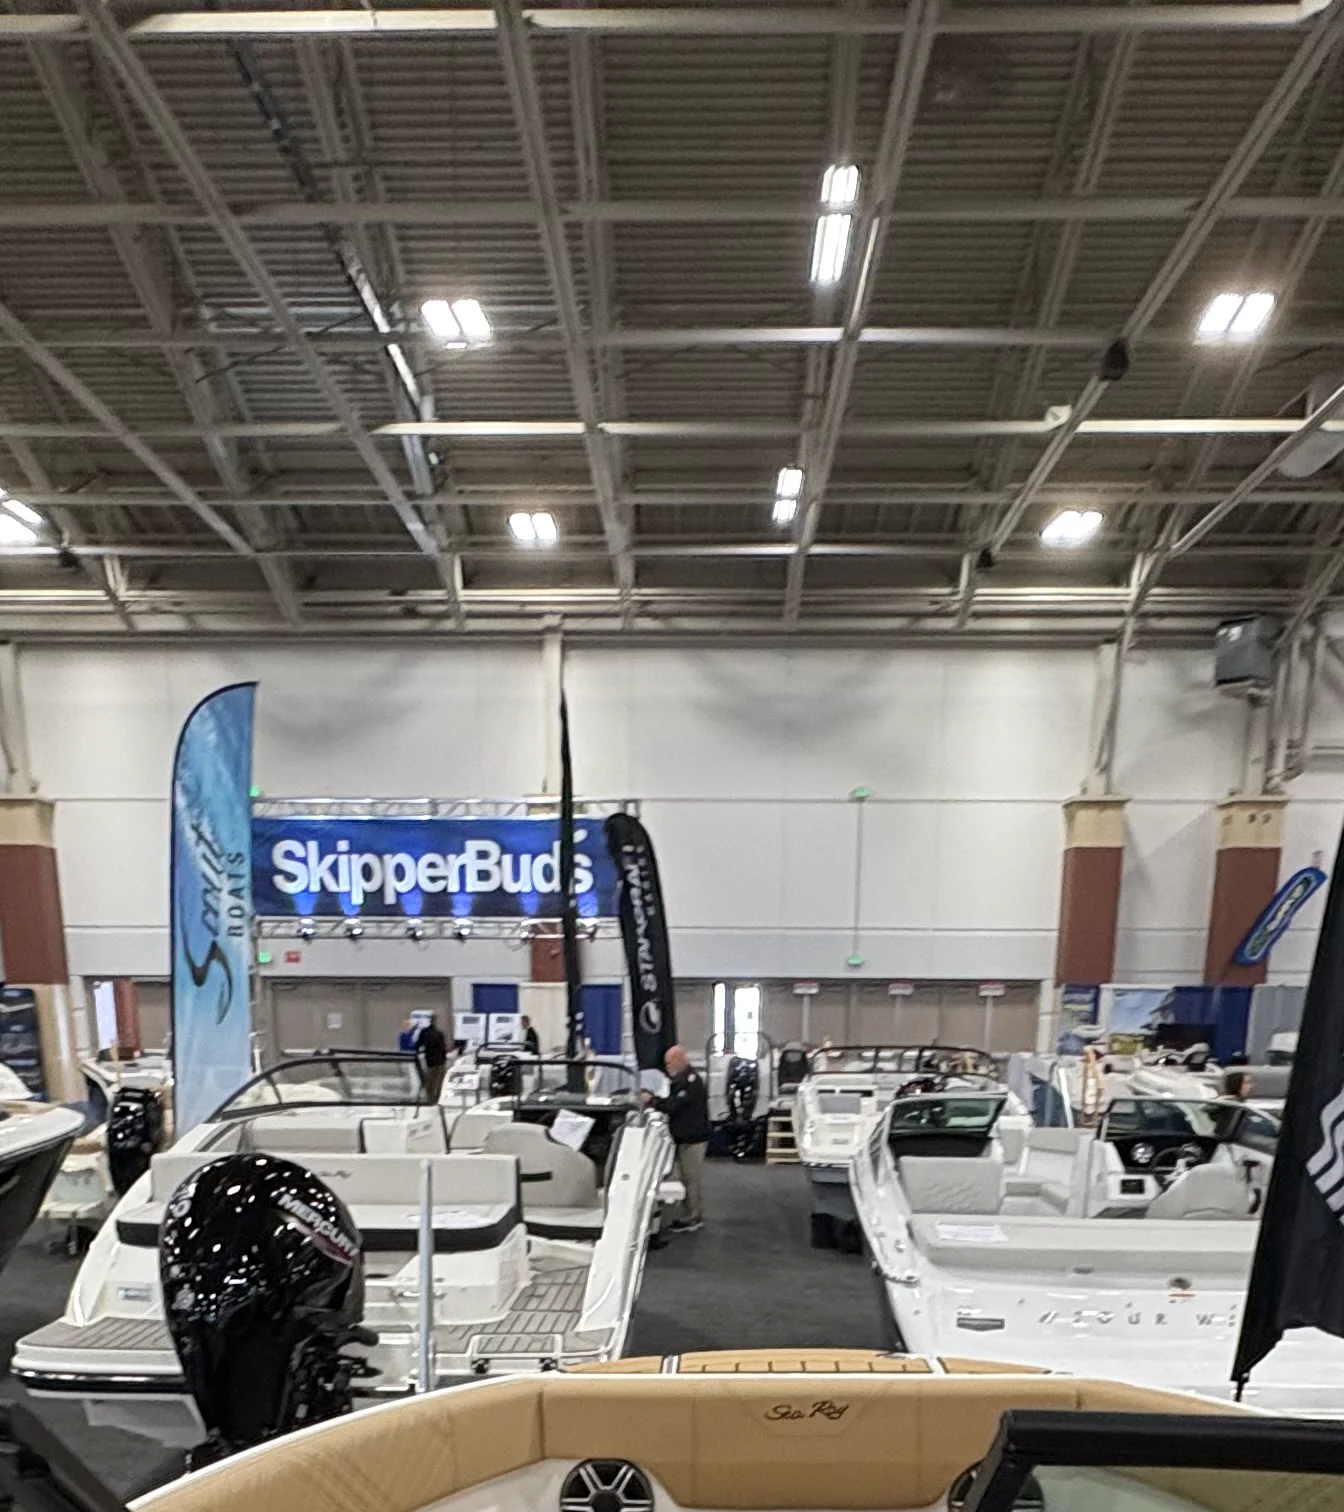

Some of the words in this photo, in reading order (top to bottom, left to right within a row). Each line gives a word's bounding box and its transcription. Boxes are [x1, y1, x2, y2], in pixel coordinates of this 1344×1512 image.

[226, 850, 246, 938] BOATS
[276, 1192, 361, 1258] MERCURY
[764, 1404, 806, 1422] Sea
[807, 1399, 851, 1421] Ray
